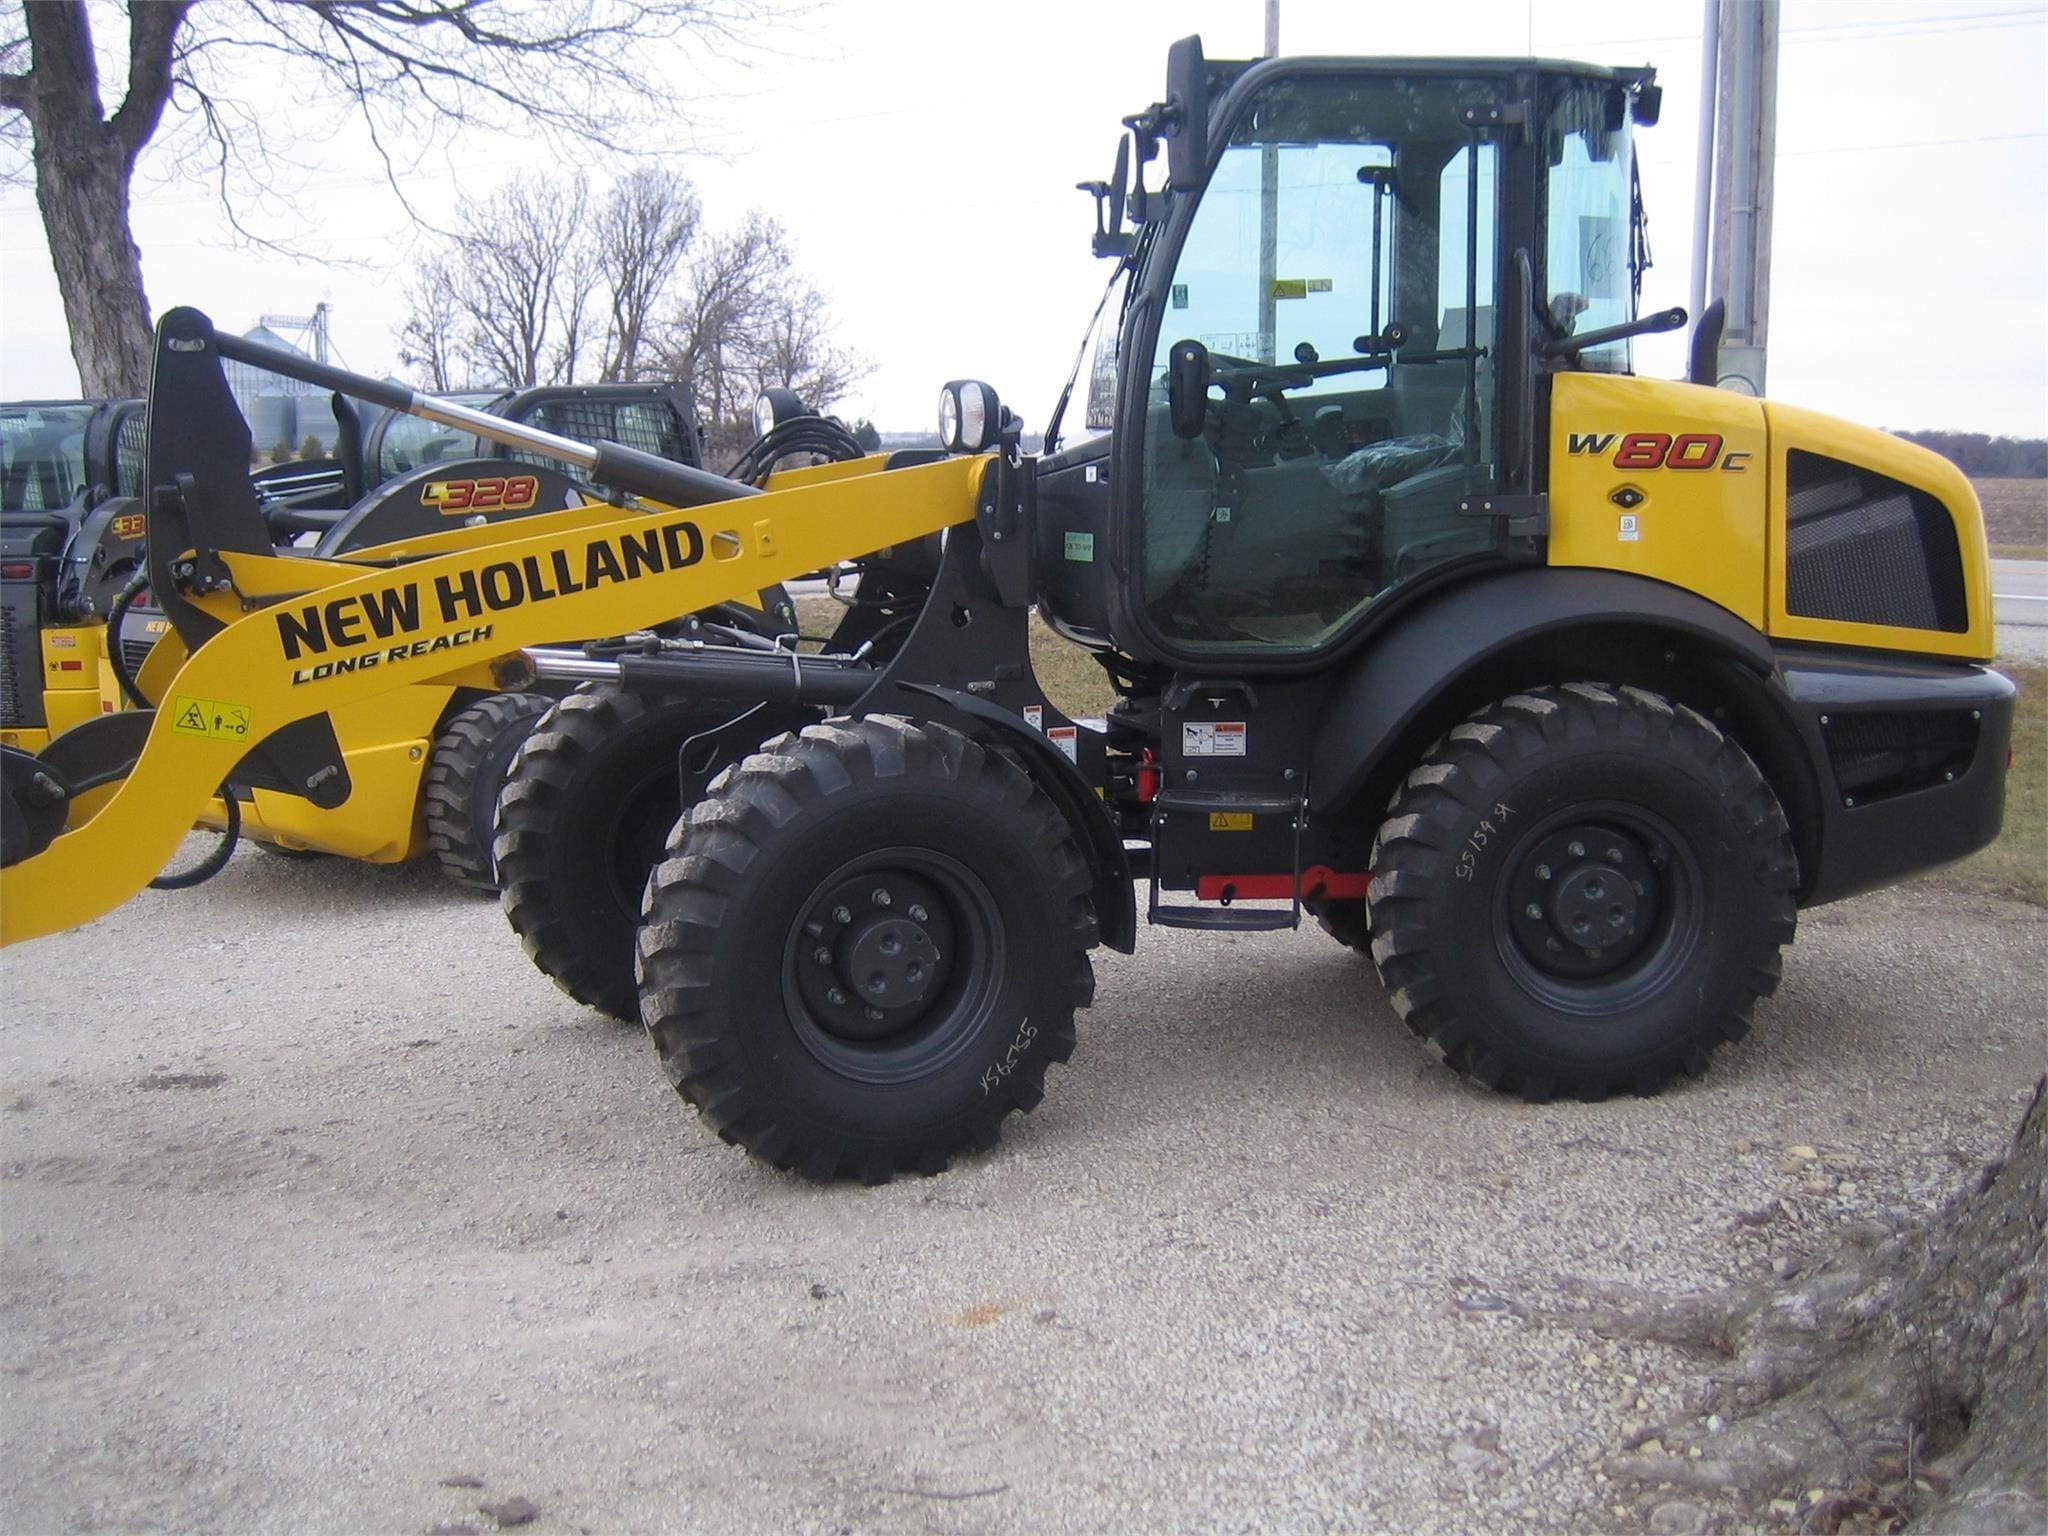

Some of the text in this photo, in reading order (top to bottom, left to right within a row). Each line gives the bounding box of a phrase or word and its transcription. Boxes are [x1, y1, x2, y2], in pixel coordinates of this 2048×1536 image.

[1567, 432, 1752, 471] W80C
[421, 475, 538, 514] L328
[275, 520, 705, 661] NEW HOLLAND
[291, 623, 495, 687] LONG REACH
